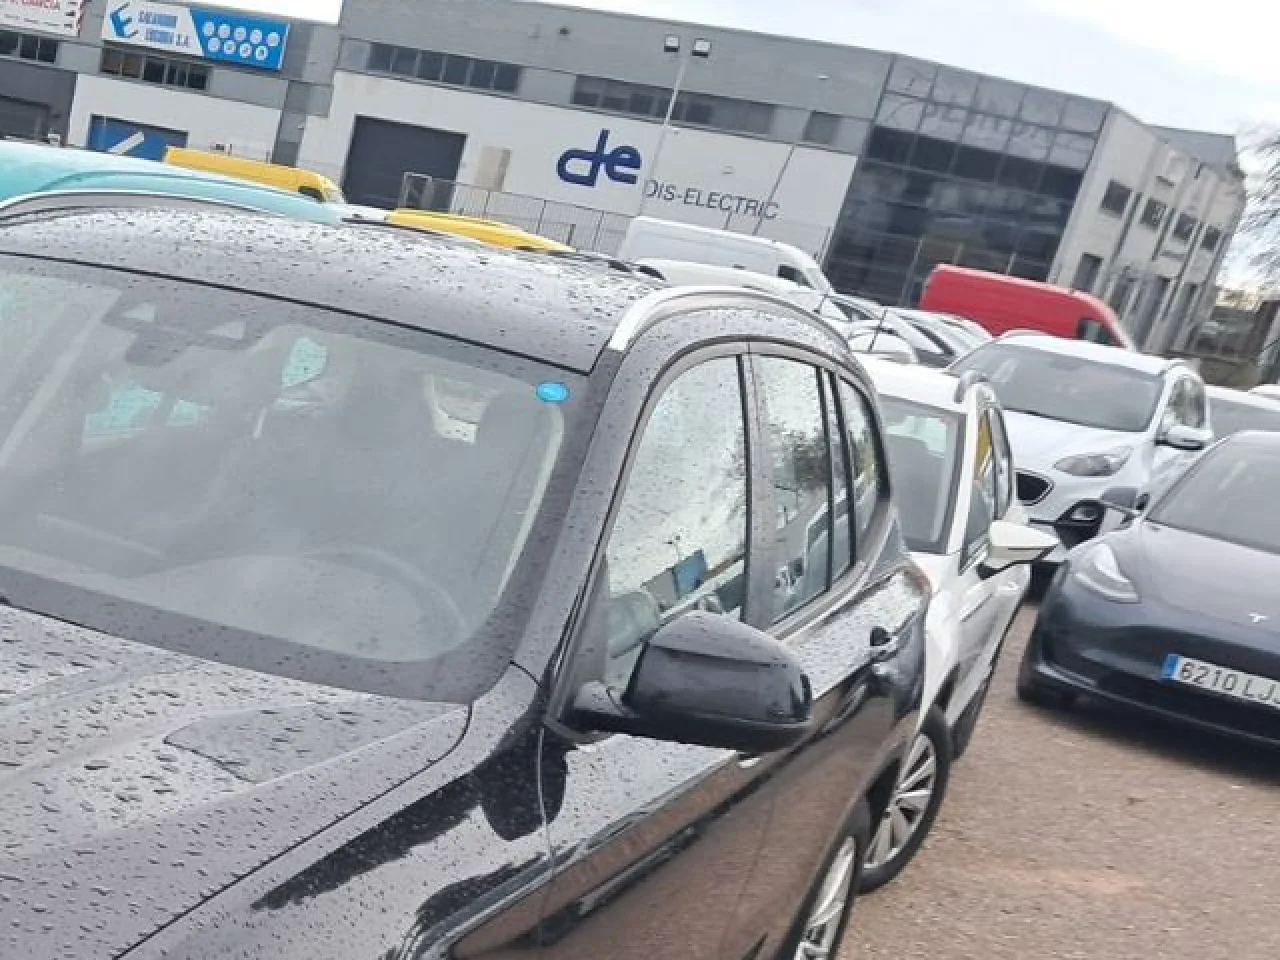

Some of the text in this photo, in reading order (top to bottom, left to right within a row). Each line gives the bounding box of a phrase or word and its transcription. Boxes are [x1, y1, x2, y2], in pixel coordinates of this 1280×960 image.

[557, 129, 642, 187] de
[645, 179, 780, 220] DIS-ELECTRIC
[1180, 662, 1280, 704] 6210 LJ
